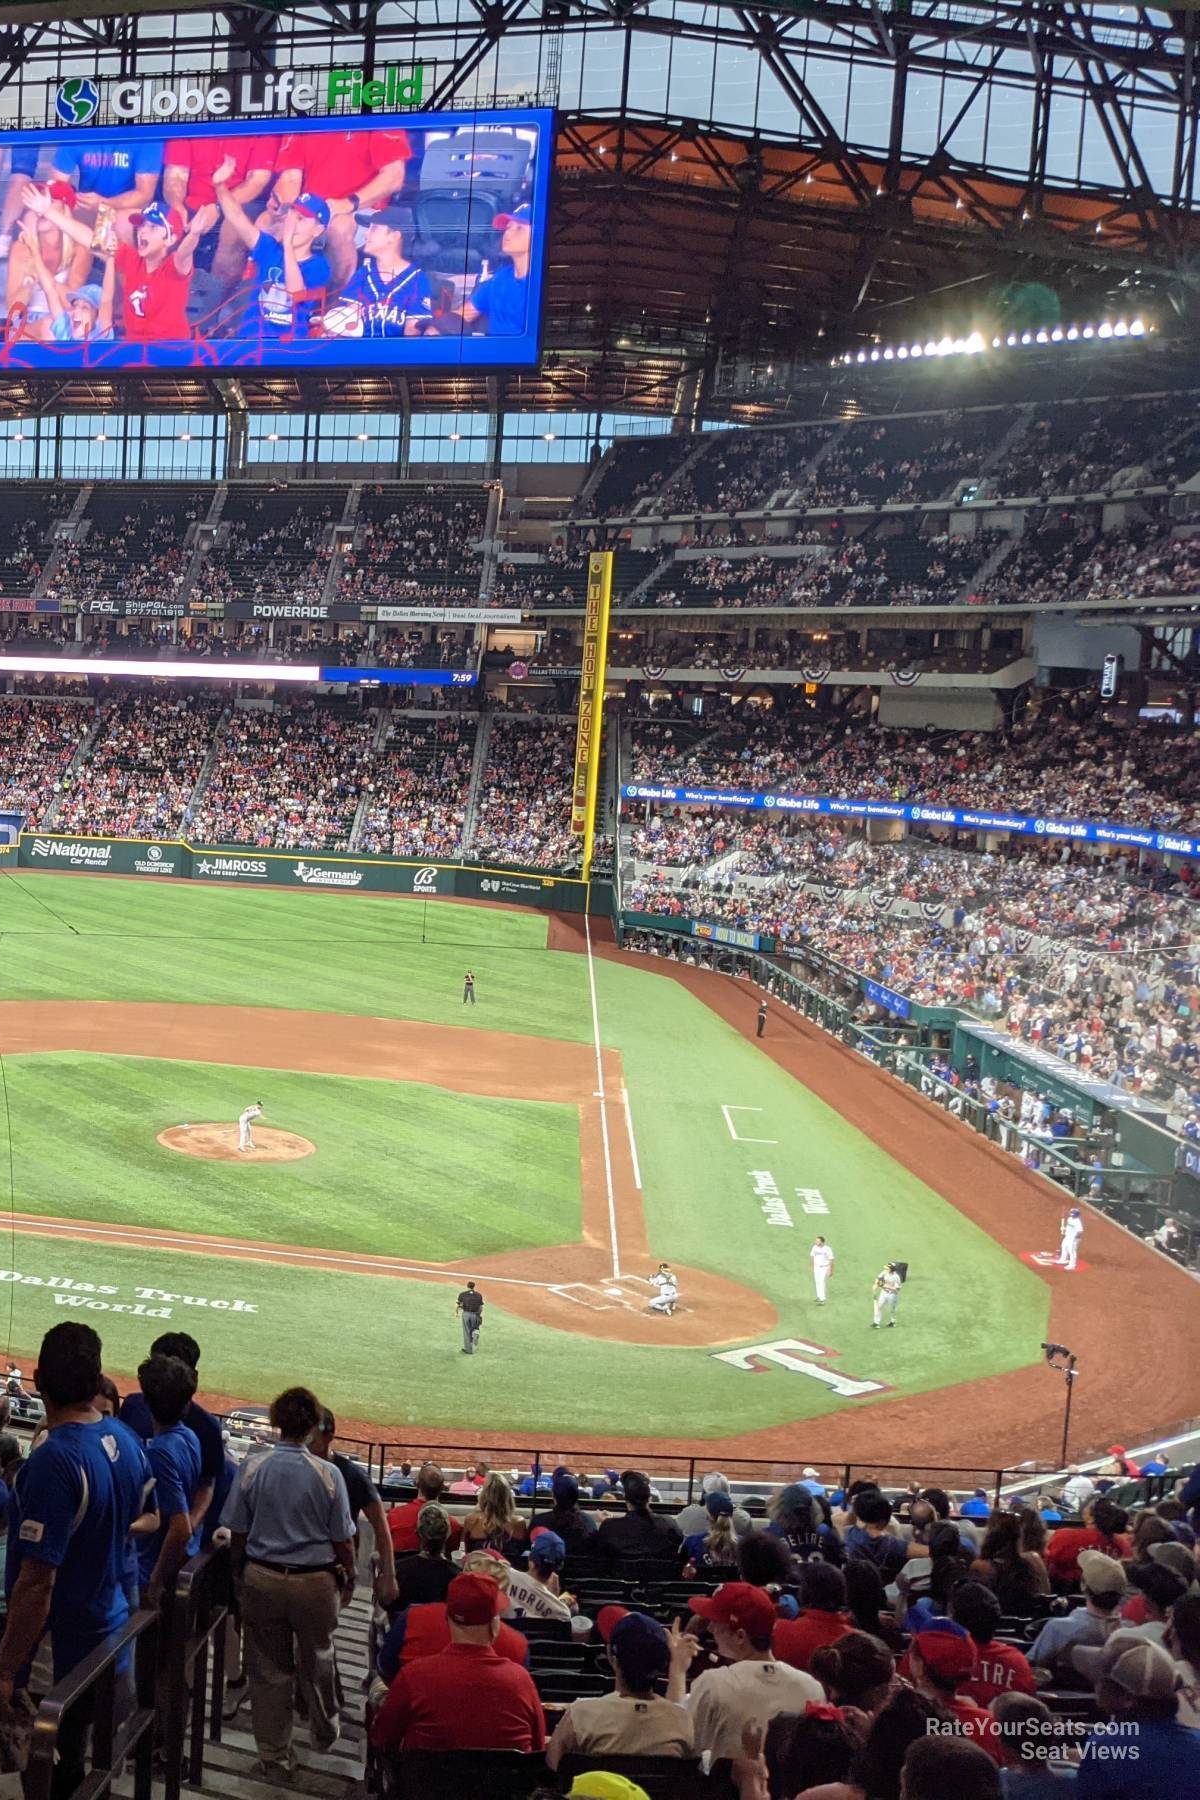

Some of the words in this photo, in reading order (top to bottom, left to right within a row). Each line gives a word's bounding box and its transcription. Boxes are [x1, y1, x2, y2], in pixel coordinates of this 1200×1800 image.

[111, 74, 229, 118] Globe
[240, 71, 316, 113] Life
[327, 65, 424, 109] Field
[89, 601, 119, 612] PGL
[253, 605, 328, 618] POWERADE
[587, 585, 600, 631] THE
[452, 673, 473, 683] 7:59
[584, 643, 597, 689] HOT
[579, 703, 592, 762] ZONE
[638, 788, 660, 798] Globe
[661, 789, 676, 799] Life
[685, 792, 703, 800] Who's
[718, 793, 754, 804] beneficiary?
[776, 798, 802, 808] Globe
[802, 799, 819, 809] Life
[830, 803, 850, 811] Who's
[851, 805, 866, 813] your
[867, 804, 904, 815] beneficiary?
[921, 810, 940, 820] Globe
[940, 811, 955, 822] Life
[1046, 823, 1069, 835] Globe
[1070, 824, 1087, 836] Life
[1096, 829, 1115, 839] Who's
[71, 857, 83, 865] Car
[84, 858, 108, 866] Rental
[313, 866, 362, 881] Germania
[413, 885, 437, 893] SPORTS
[746, 1170, 780, 1196] Truck
[761, 1197, 794, 1227] Dallas
[794, 1188, 831, 1214] World
[52, 1293, 172, 1319] World
[135, 1287, 259, 1313] Truck
[709, 1338, 898, 1398] T
